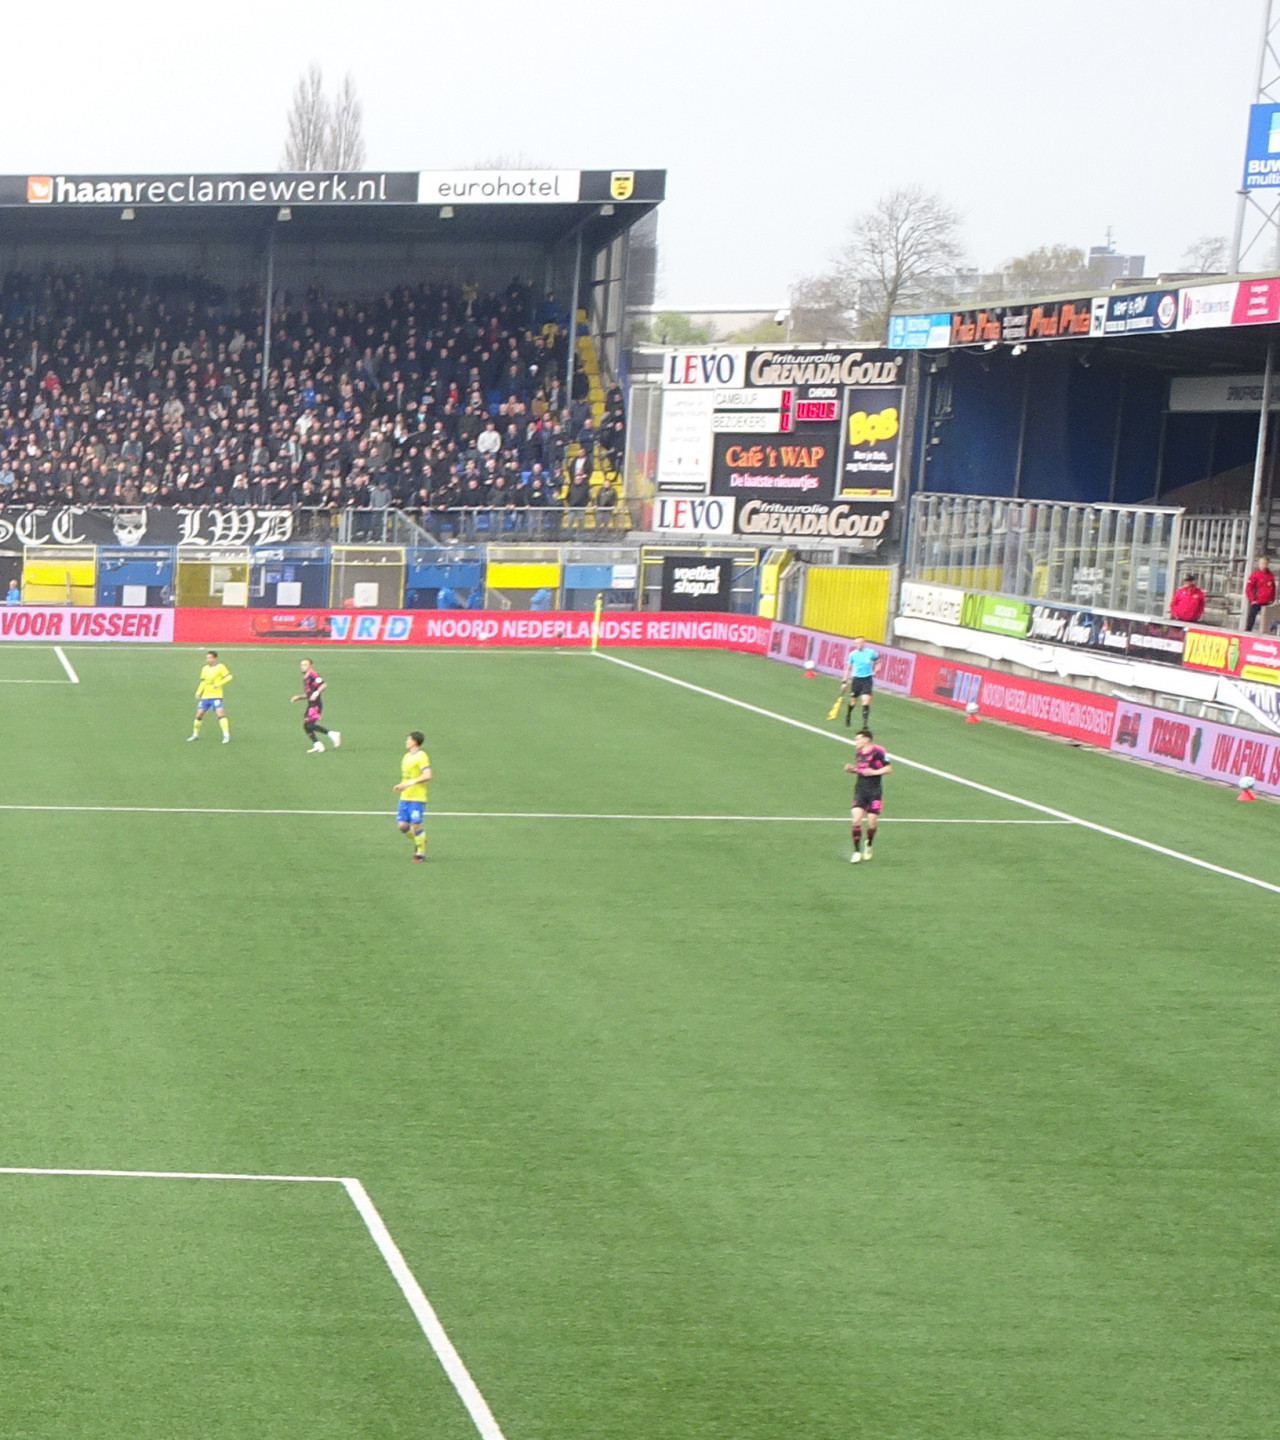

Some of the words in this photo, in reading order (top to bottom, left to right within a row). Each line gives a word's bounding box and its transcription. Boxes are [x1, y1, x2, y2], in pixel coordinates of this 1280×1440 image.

[56, 175, 386, 203] haanreclamewerk.nl
[438, 175, 560, 197] eurohotel
[668, 353, 735, 384] LEVO
[771, 353, 841, 364] frituurolie
[725, 446, 762, 468] Café
[780, 446, 826, 468] WAP
[730, 473, 742, 487] De
[744, 473, 773, 487] laatste
[657, 500, 723, 530] LEVO
[758, 503, 829, 515] frituurolie
[673, 565, 721, 581] voetbal
[673, 580, 719, 597] shop.nl
[2, 612, 64, 636] VOOR
[70, 613, 162, 637] VISSER!
[331, 615, 413, 640] NRD
[427, 619, 499, 638] NOORD
[502, 620, 643, 639] NEDERLANDSE
[1184, 631, 1229, 668] VISSER
[1148, 717, 1191, 761] VISSER
